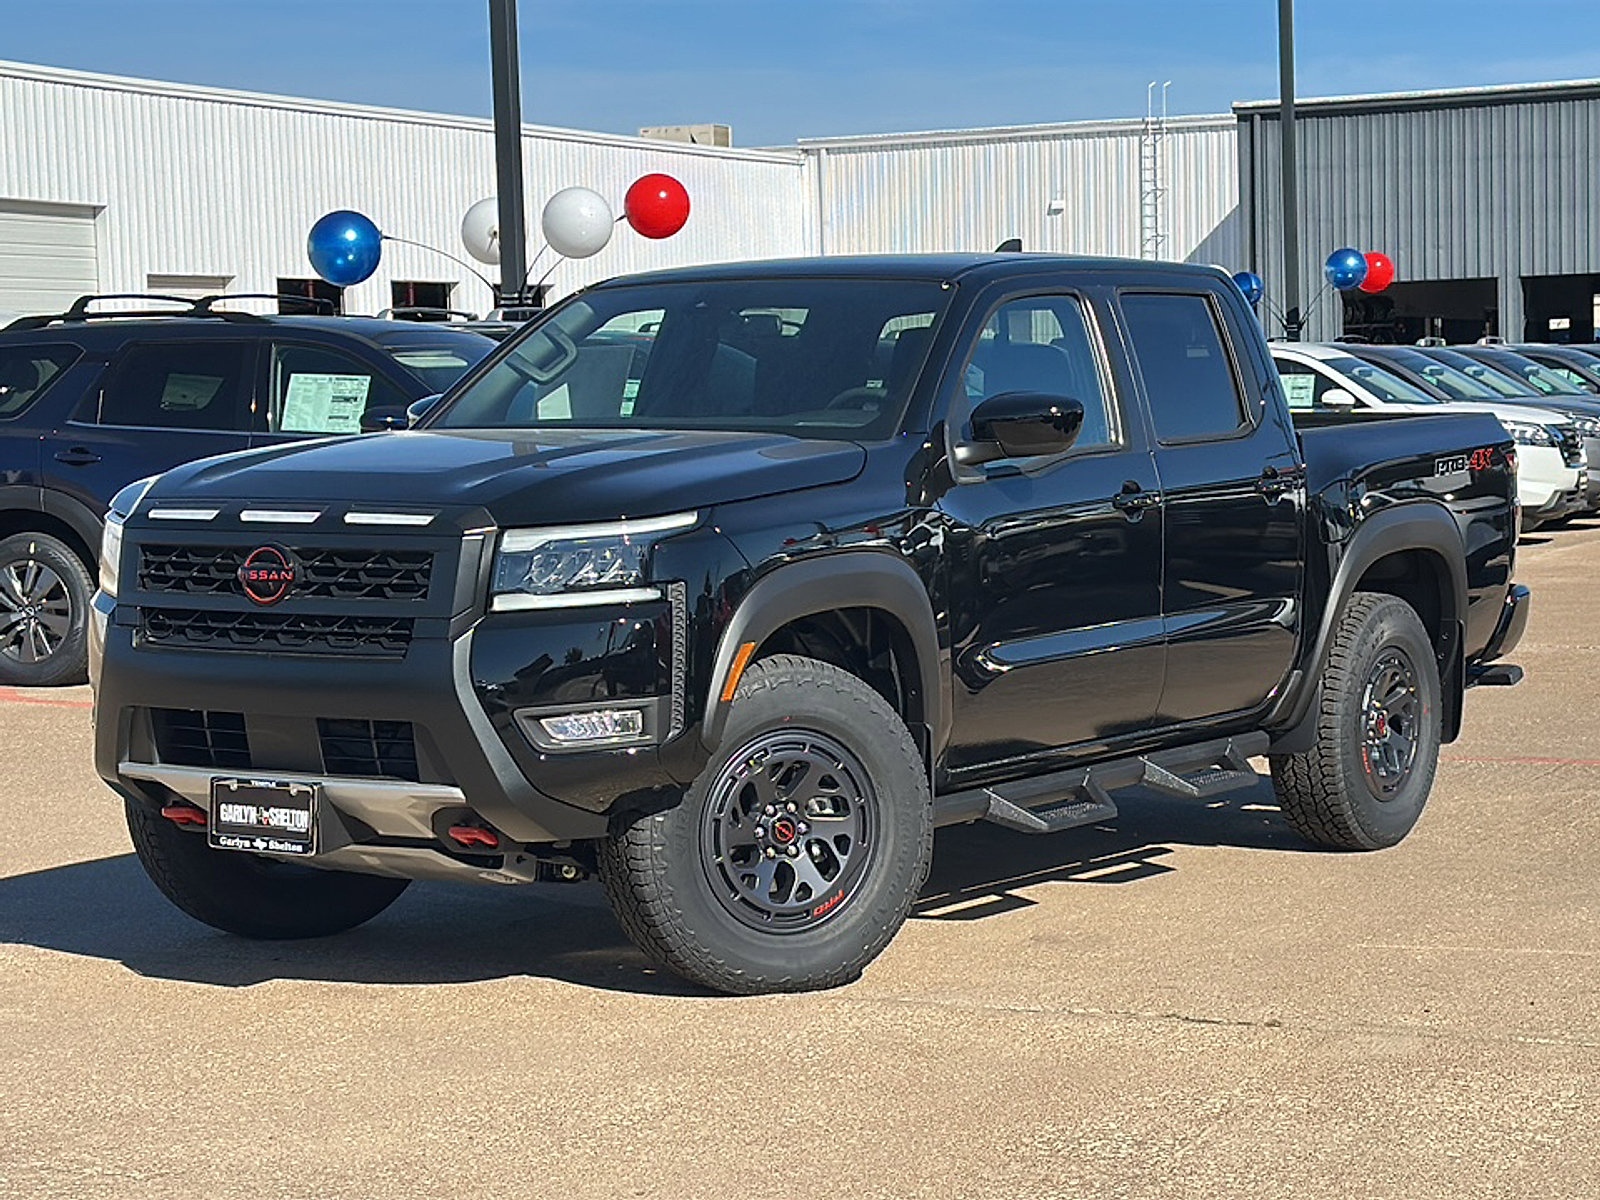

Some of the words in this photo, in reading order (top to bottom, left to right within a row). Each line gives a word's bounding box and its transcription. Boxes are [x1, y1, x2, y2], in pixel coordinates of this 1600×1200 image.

[220, 803, 257, 825] GARLYN
[269, 807, 309, 829] SHELTON
[219, 836, 251, 849] Garlyn
[268, 840, 303, 853] Shelton
